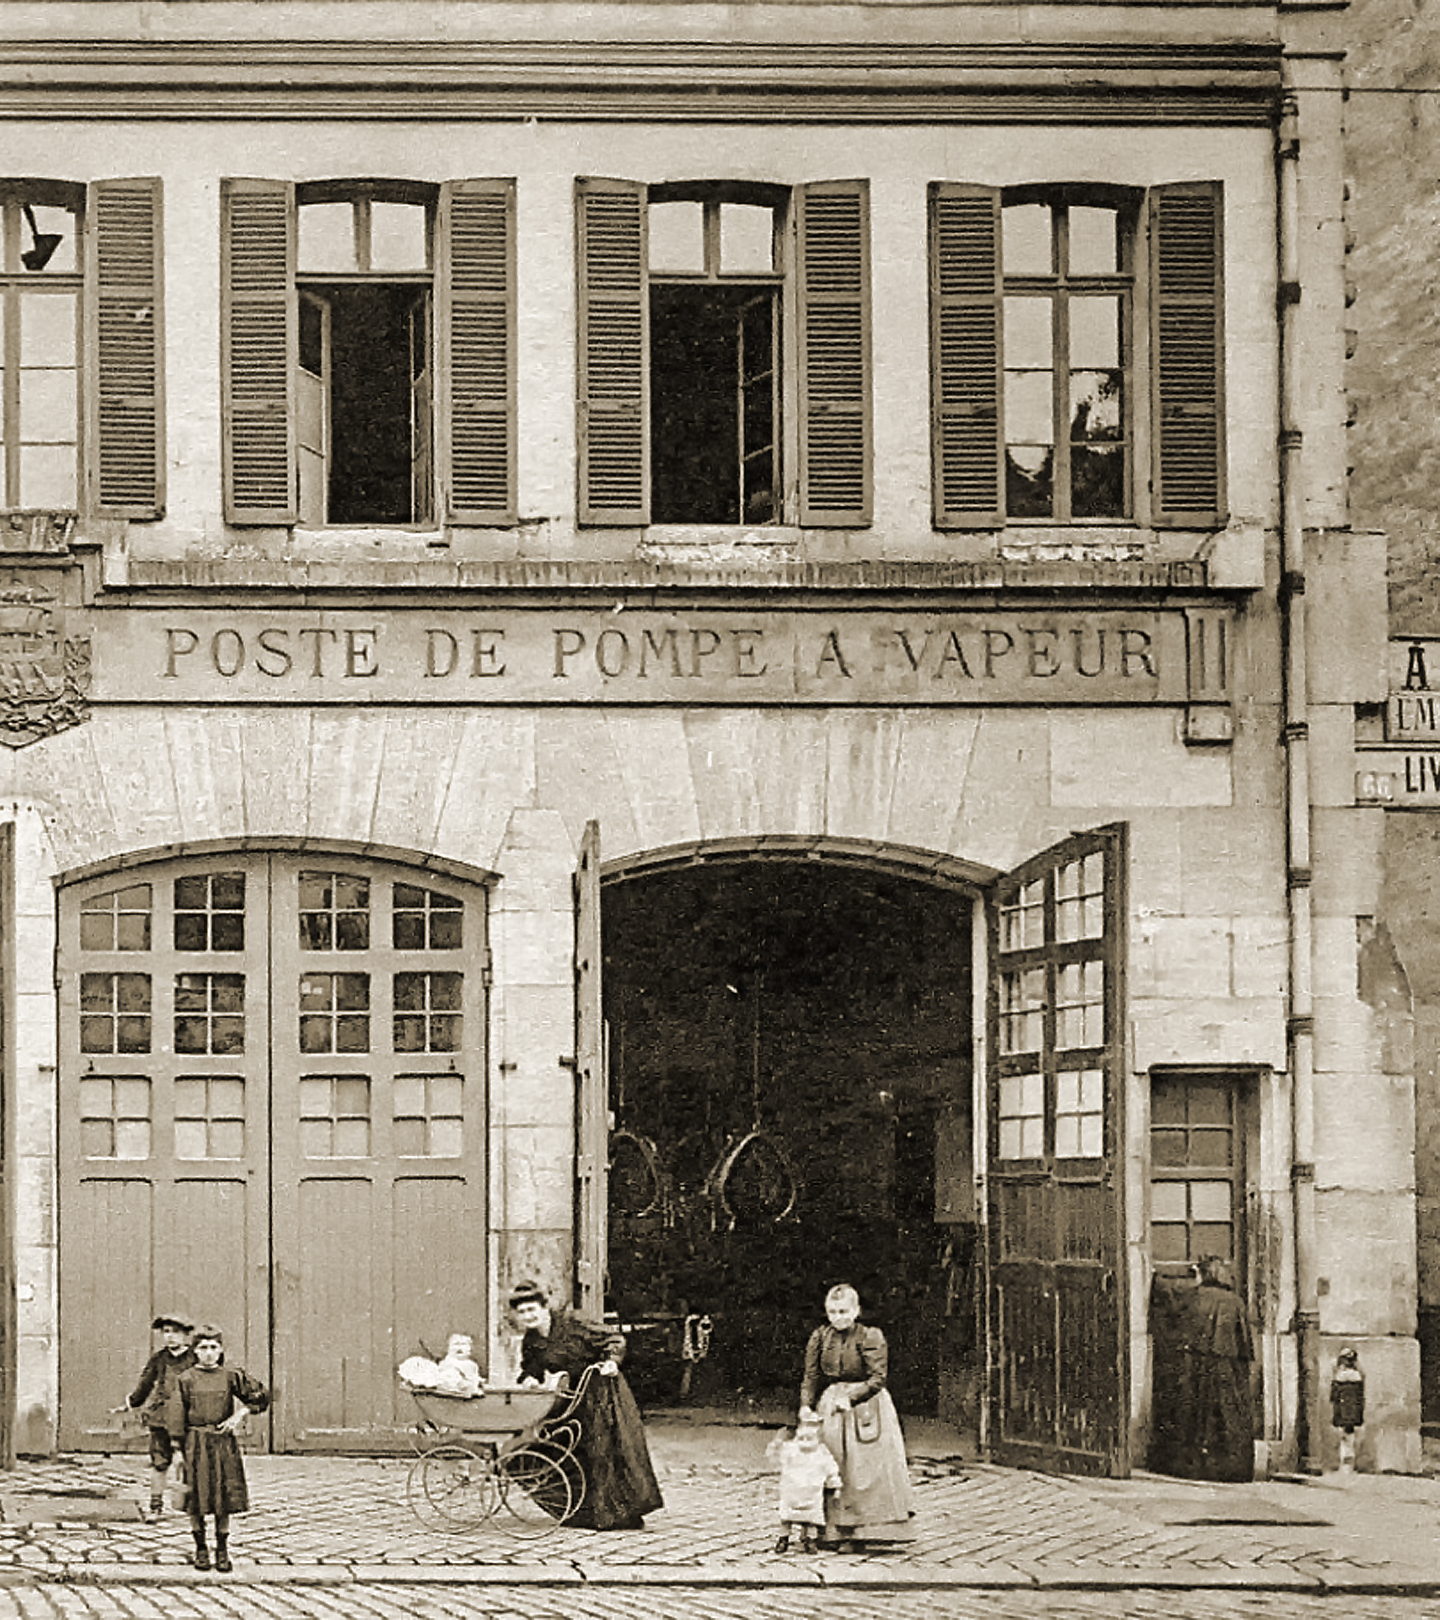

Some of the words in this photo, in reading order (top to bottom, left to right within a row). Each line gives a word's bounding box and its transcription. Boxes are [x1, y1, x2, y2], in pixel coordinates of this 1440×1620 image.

[162, 627, 380, 679] POSTE
[422, 627, 507, 679] DE
[551, 627, 768, 679] POMPE
[893, 627, 1160, 679] VAPEUR
